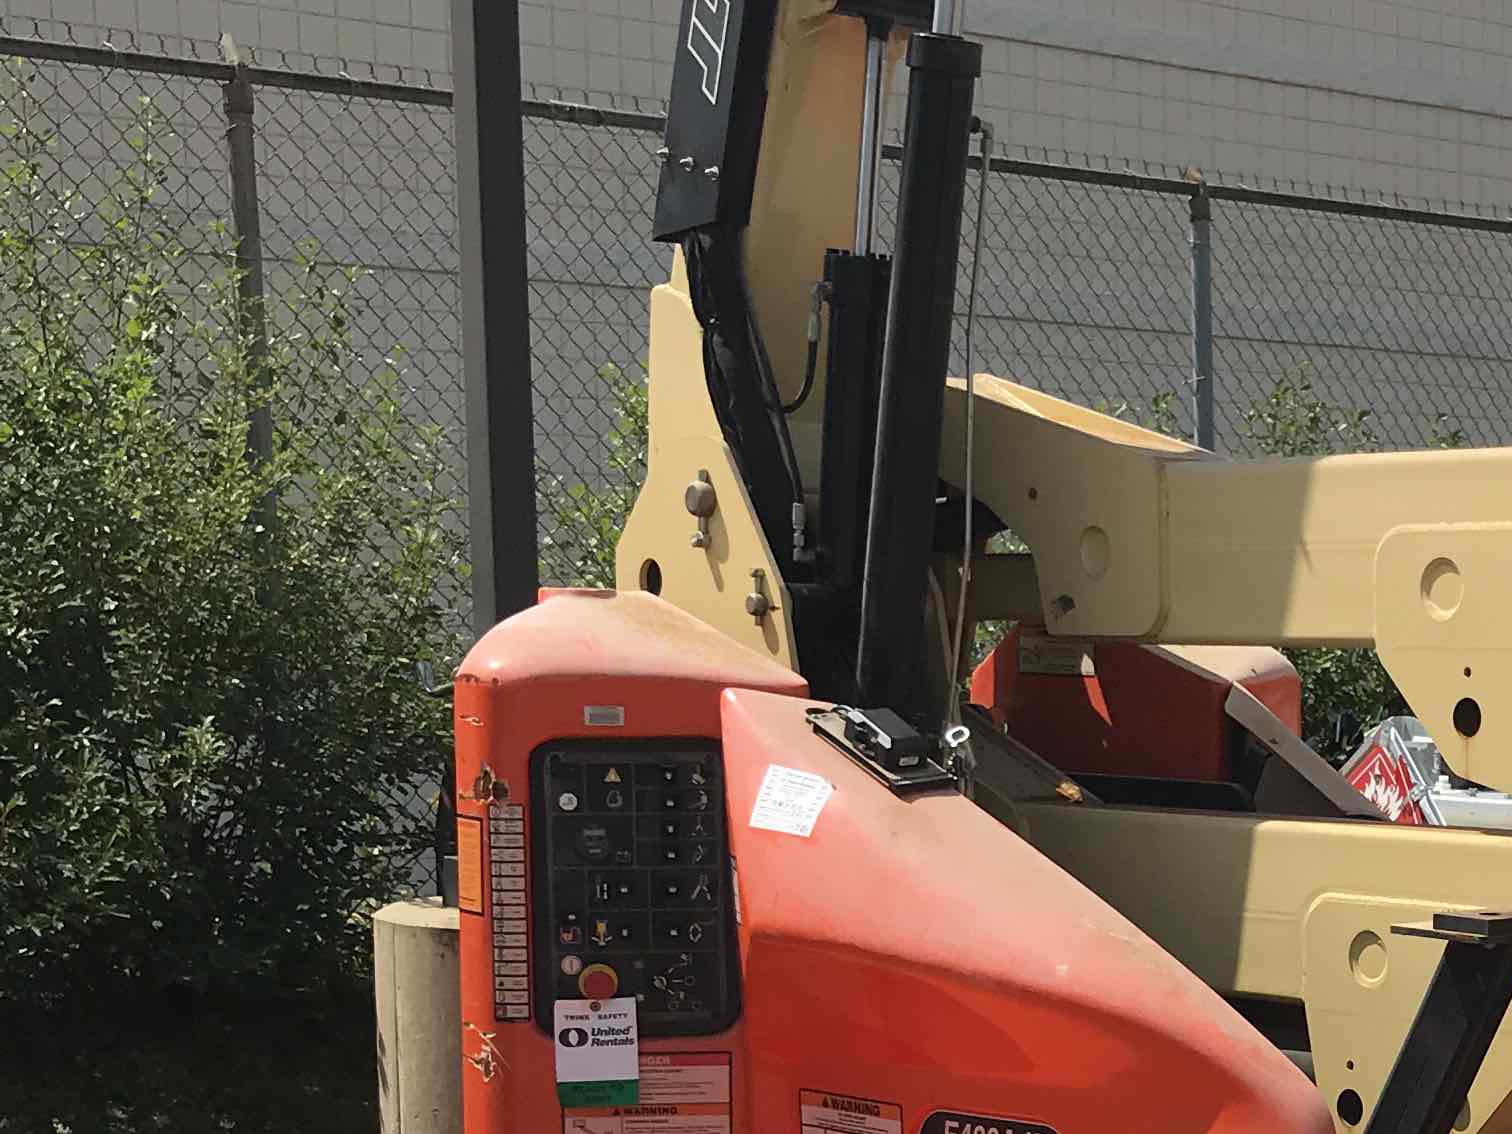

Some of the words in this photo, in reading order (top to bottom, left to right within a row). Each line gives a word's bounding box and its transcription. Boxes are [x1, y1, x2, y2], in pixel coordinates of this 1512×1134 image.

[688, 0, 729, 105] JL
[598, 1012, 628, 1020] SAFETY
[591, 1025, 633, 1037] United
[590, 1036, 634, 1047] Rentals
[831, 1097, 880, 1116] WARNING
